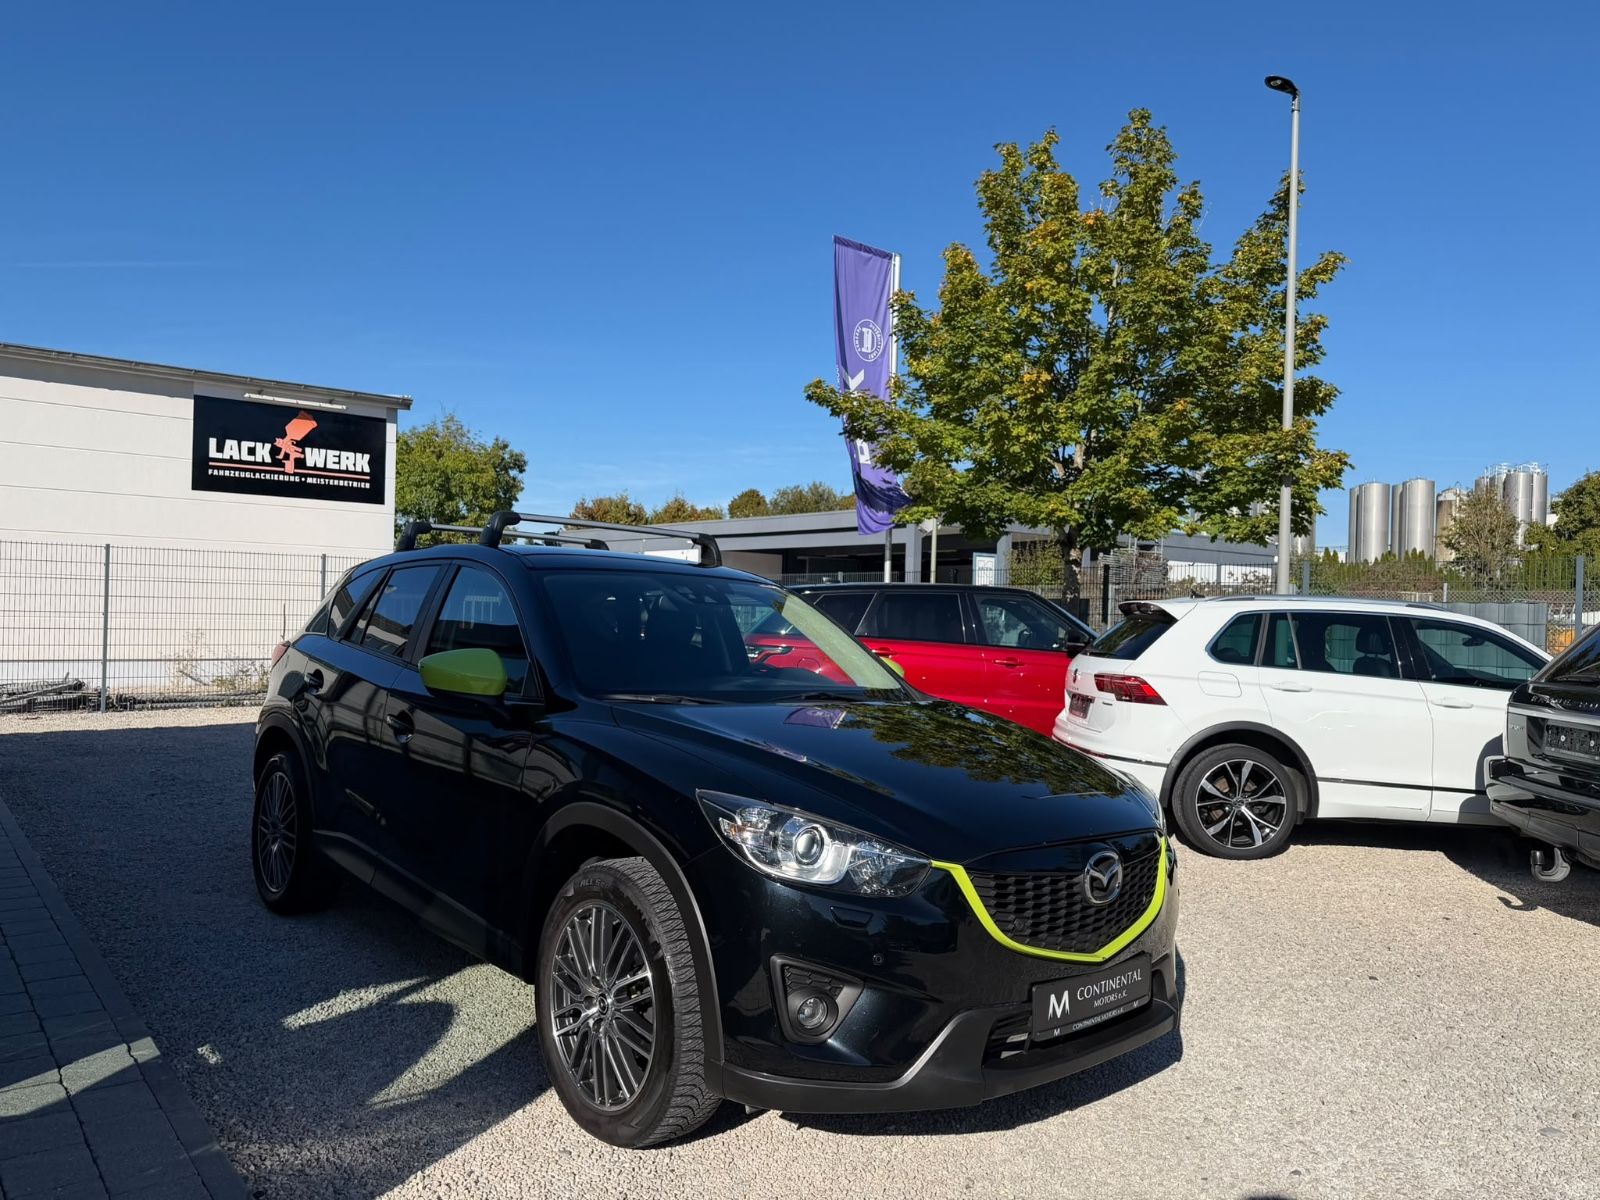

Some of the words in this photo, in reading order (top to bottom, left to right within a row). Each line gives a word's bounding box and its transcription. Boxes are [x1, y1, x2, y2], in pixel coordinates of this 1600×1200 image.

[208, 437, 272, 463] LACK
[304, 447, 371, 473] WERK
[208, 469, 300, 483] FAHRZEUGLACKIERUNG
[306, 476, 370, 489] MEISTERBETRIEB
[1077, 969, 1142, 1001] CONTINENTAL
[1094, 992, 1118, 1008] MOTORS
[1048, 990, 1070, 1021] M
